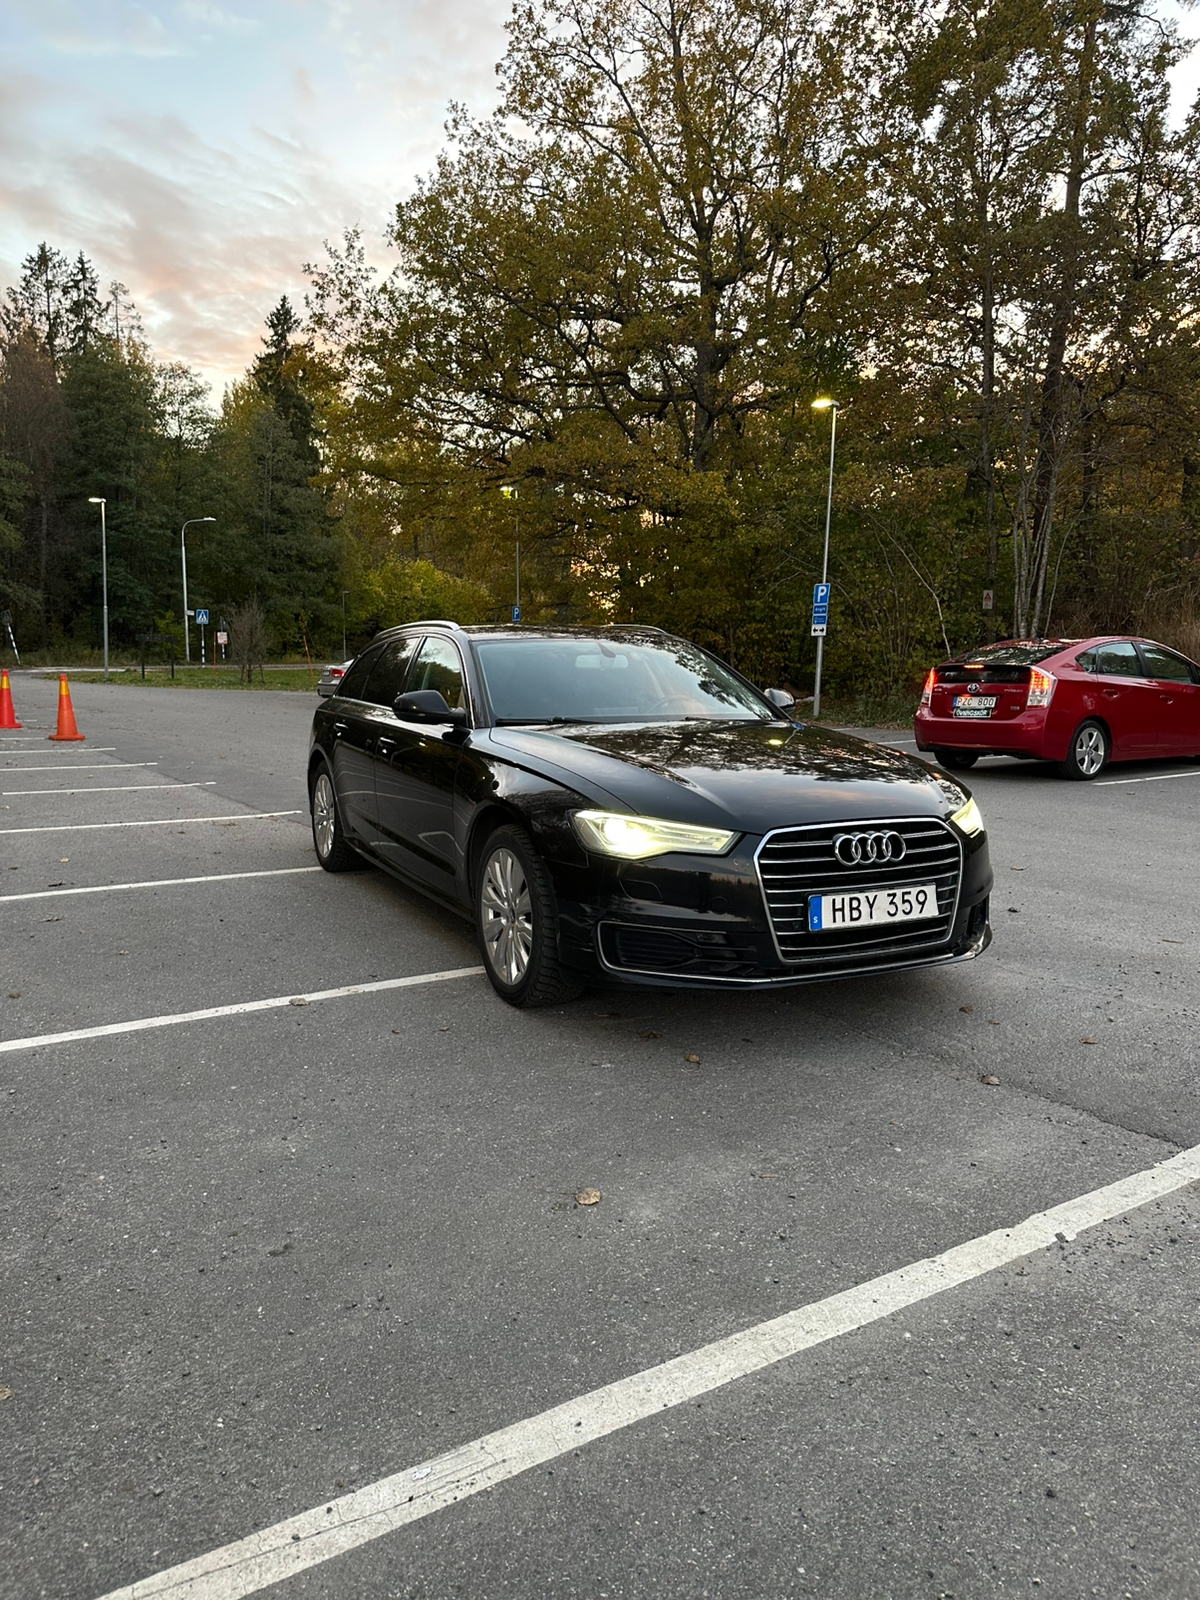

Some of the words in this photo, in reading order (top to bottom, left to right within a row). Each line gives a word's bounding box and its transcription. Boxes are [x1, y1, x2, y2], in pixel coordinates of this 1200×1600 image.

[817, 586, 827, 602] P
[957, 698, 973, 706] PZC
[978, 698, 995, 706] 800
[832, 894, 878, 923] HBY
[887, 890, 928, 917] 359
